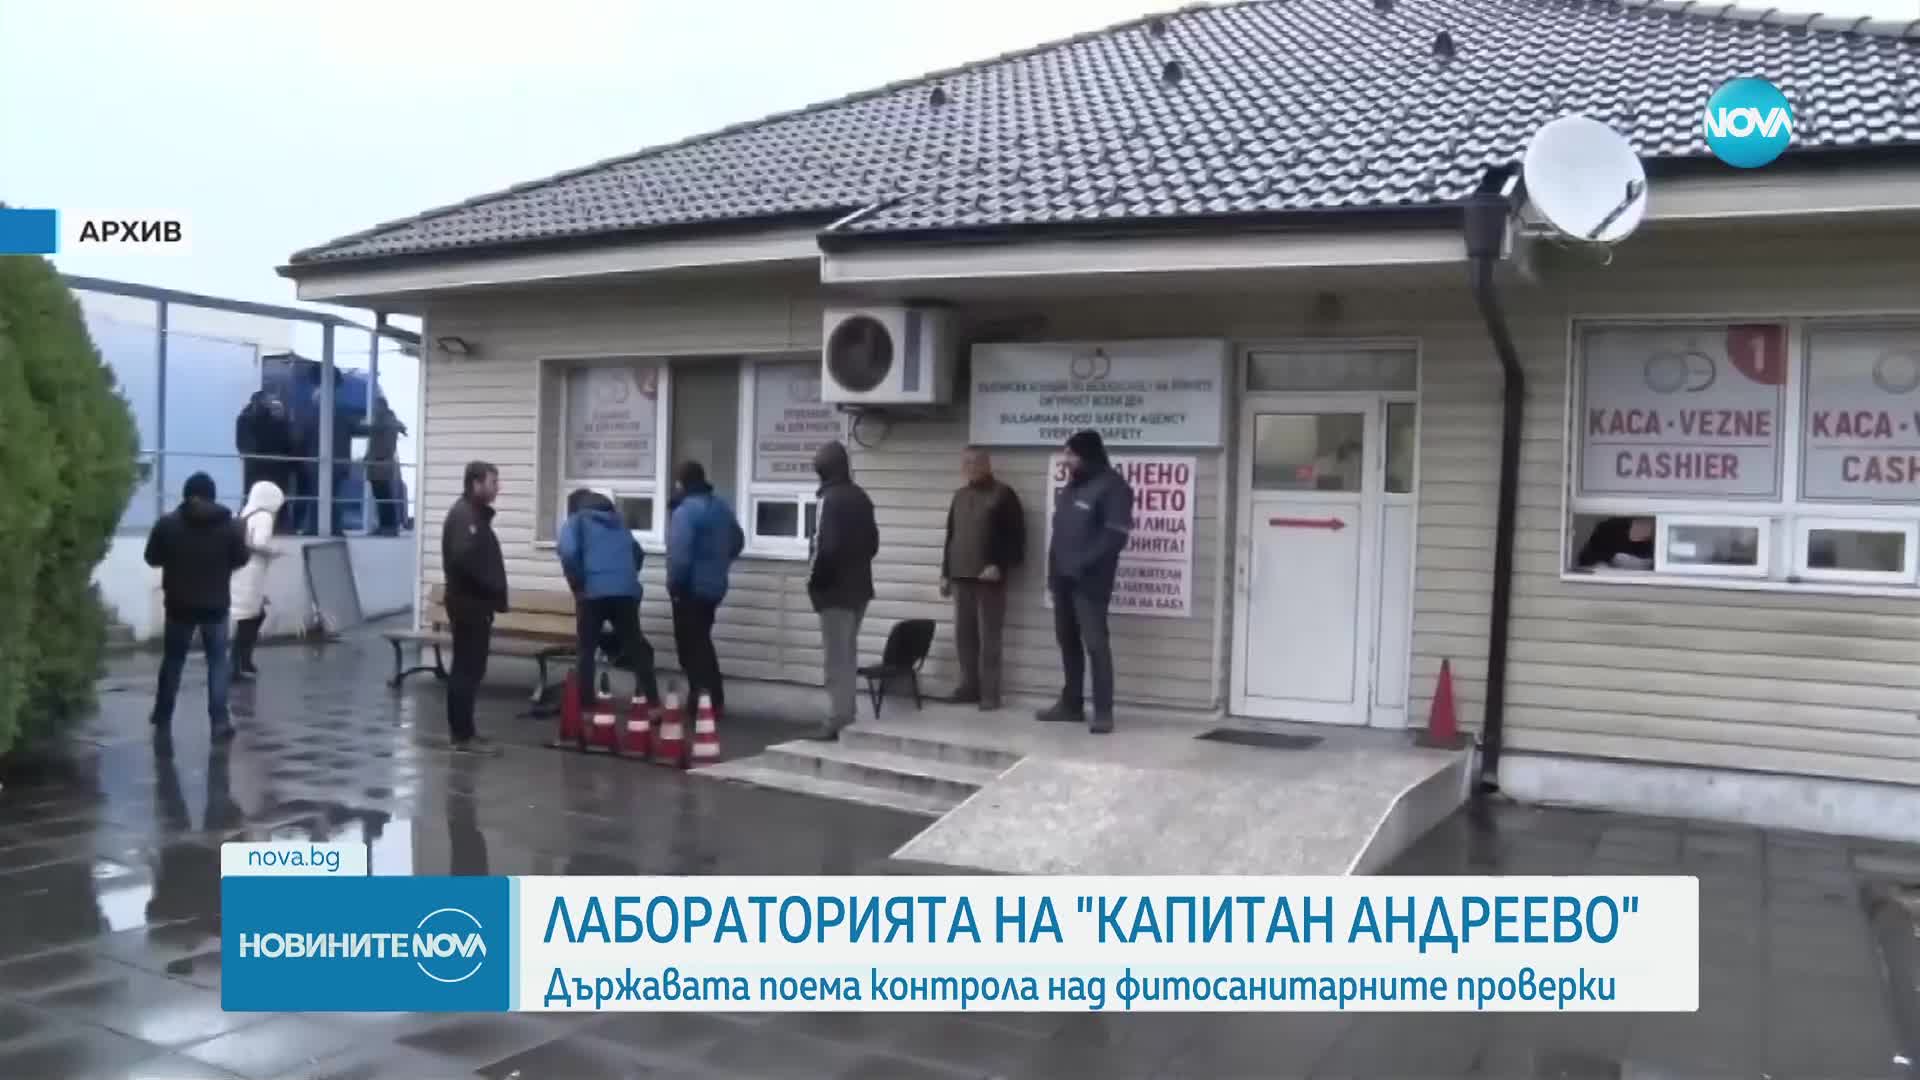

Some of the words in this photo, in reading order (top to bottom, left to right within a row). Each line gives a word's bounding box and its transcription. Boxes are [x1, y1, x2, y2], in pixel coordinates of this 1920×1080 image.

[1748, 334, 1767, 374] 1
[1061, 412, 1092, 425] FOOD
[1095, 411, 1137, 425] SAFETY
[1140, 411, 1186, 425] AGENCY
[1680, 410, 1771, 437] VEZNE
[1102, 427, 1144, 440] SAFETY
[1616, 451, 1739, 480] CASHIER
[1842, 455, 1920, 483] CASH
[1144, 516, 1187, 533] ЛИЦА
